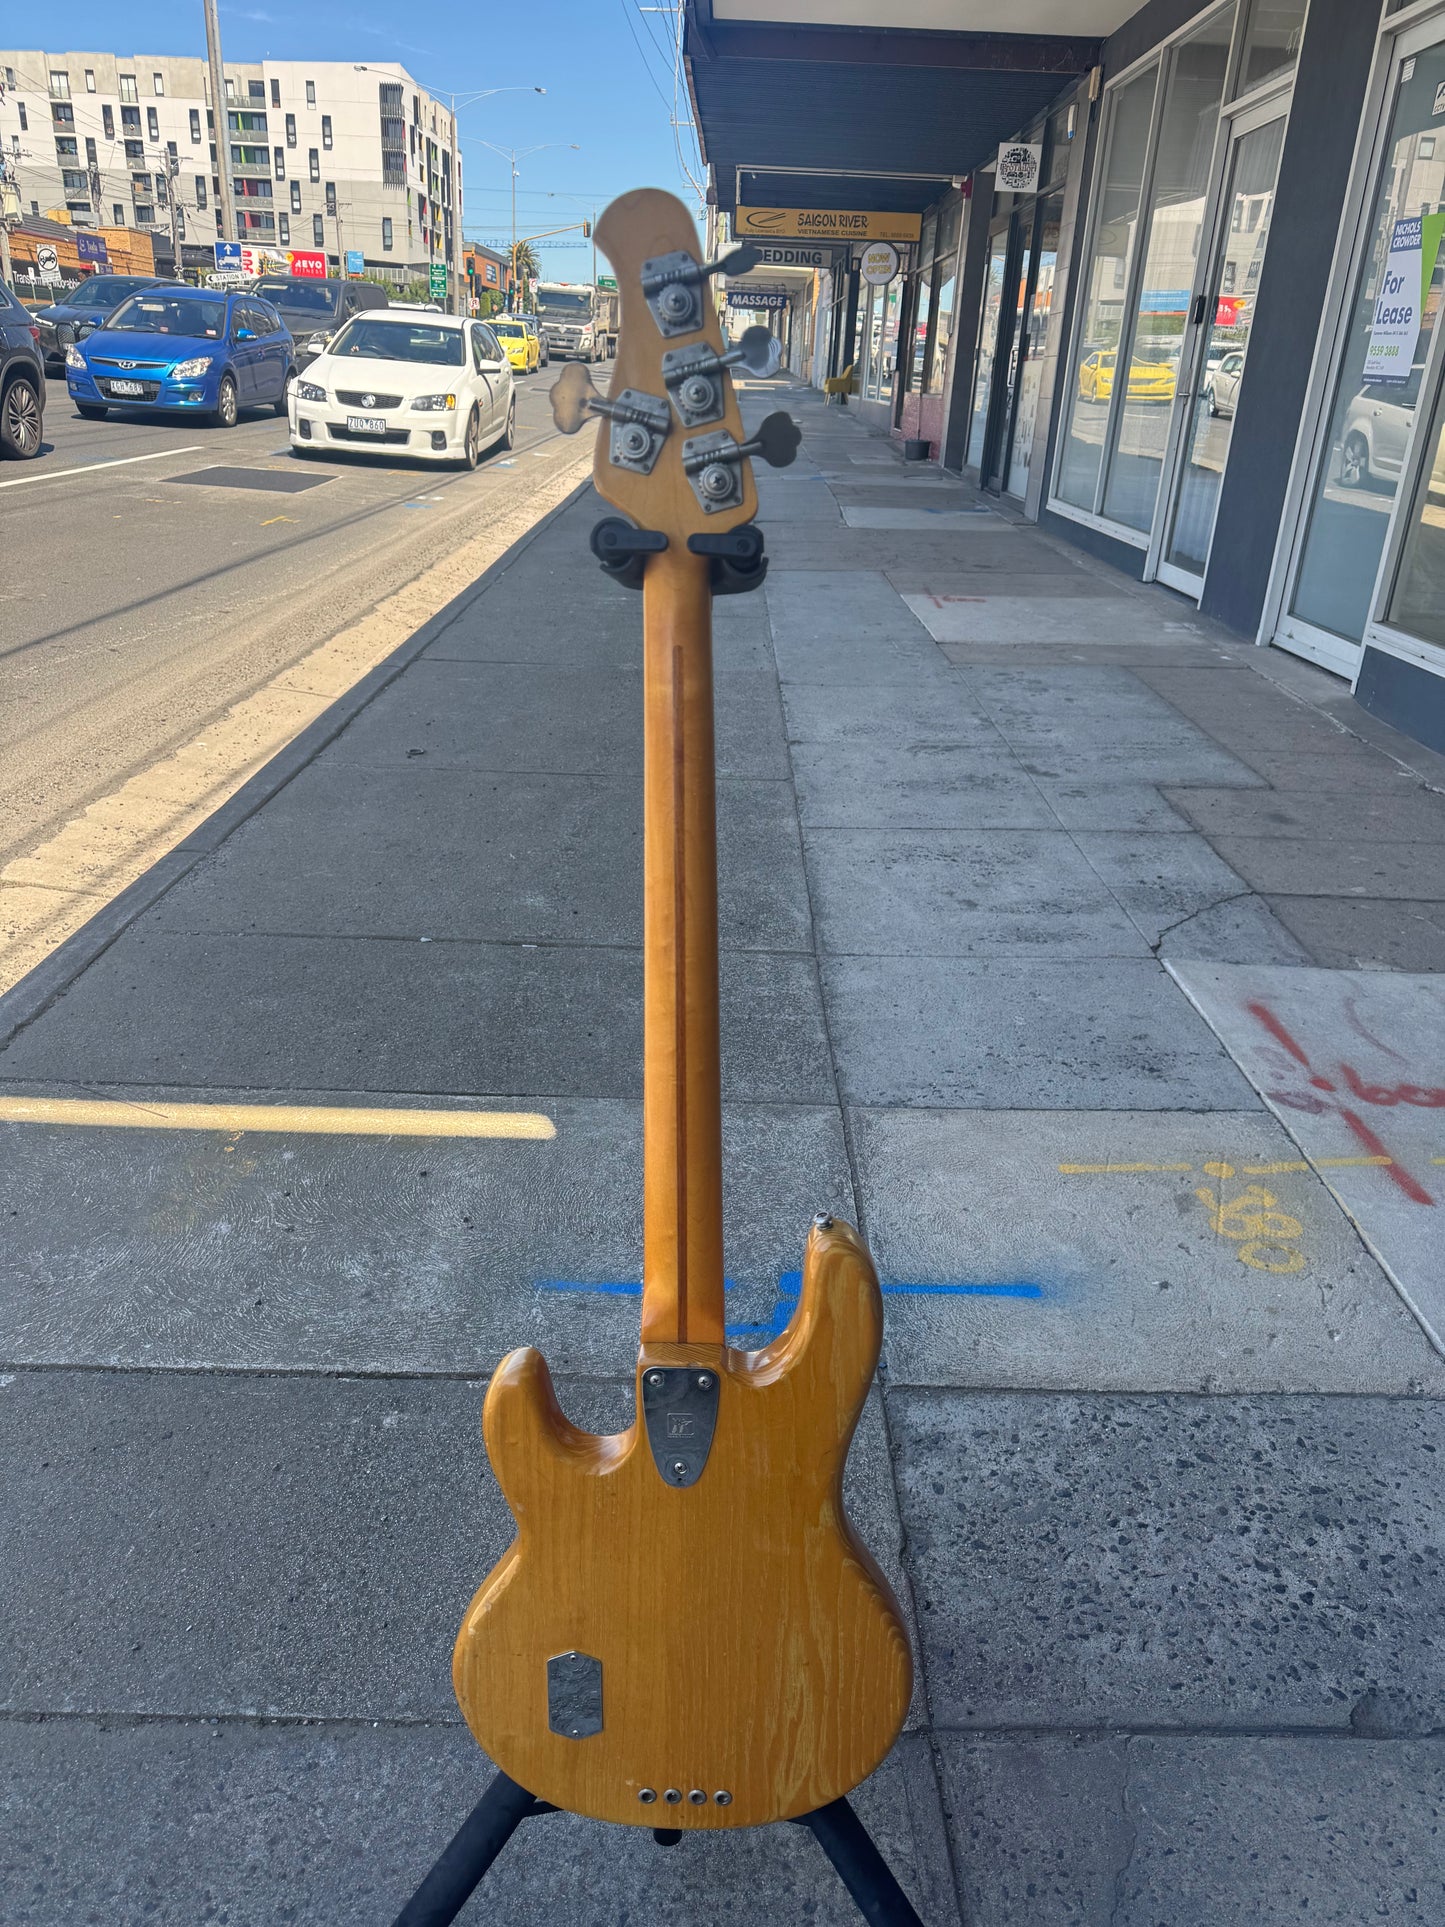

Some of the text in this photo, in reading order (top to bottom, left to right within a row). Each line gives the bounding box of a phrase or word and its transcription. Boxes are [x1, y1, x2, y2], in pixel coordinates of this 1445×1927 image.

[797, 213, 869, 228] SAIGON RIVER
[1392, 221, 1422, 248] NICHOLS CROWDER
[760, 249, 822, 264] EDDING
[867, 252, 891, 264] NOW
[294, 259, 323, 269] REVO
[866, 265, 892, 275] OPEN
[215, 273, 240, 281] STATION
[1382, 270, 1405, 295] For
[731, 294, 784, 306] MASSAGE
[1375, 301, 1413, 325] Lease
[369, 420, 384, 430] 860
